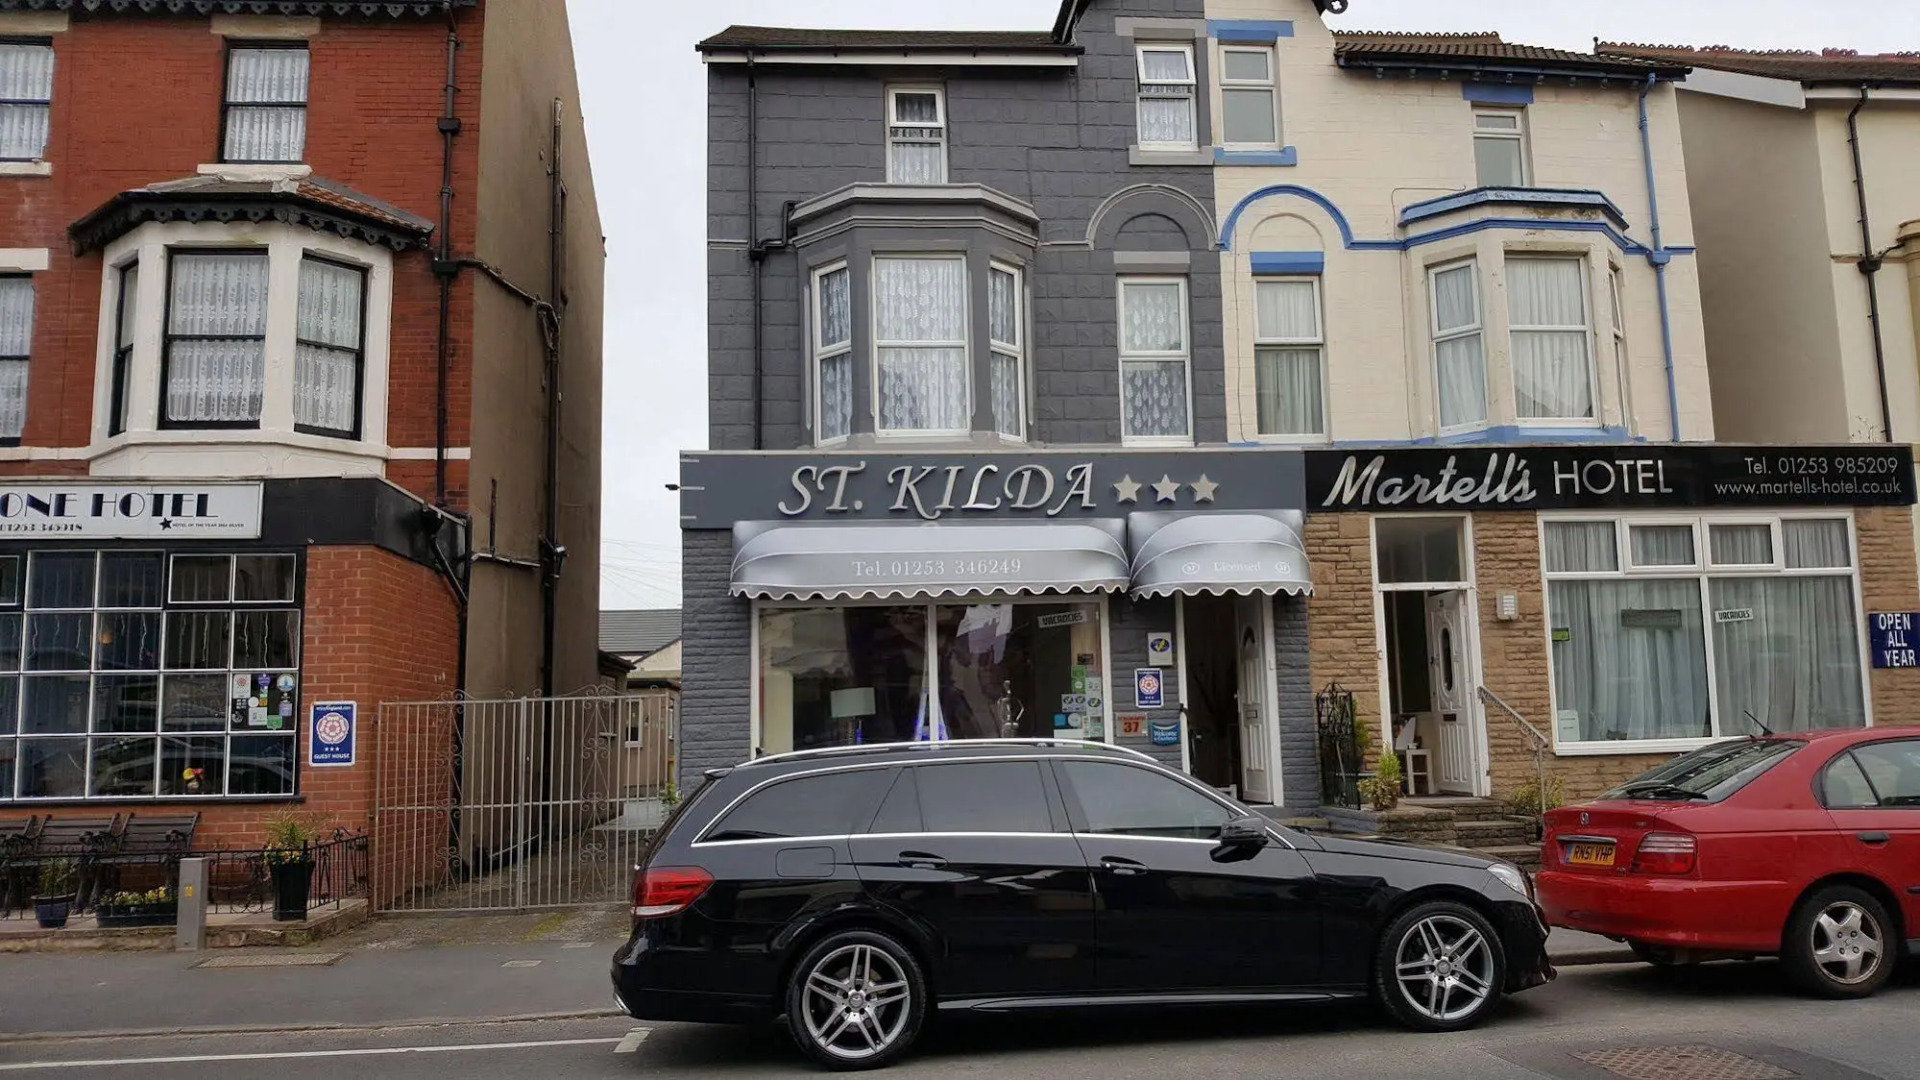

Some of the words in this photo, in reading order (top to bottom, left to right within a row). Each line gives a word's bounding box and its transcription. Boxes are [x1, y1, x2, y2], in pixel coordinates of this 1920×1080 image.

[1744, 456, 1772, 474] Tel.
[1778, 457, 1829, 474] 01253
[1834, 456, 1898, 474] 985209
[1321, 452, 1536, 506] Martell's
[1553, 459, 1673, 494] HOTEL
[1714, 475, 1902, 495] www.martells-hotel.co.uk
[777, 460, 866, 515] ST.
[887, 462, 1097, 520] KILDA
[91, 492, 219, 518] HOTEL
[852, 561, 886, 576] Tel.
[891, 560, 945, 576] 01253
[954, 558, 1021, 575] 346249
[1042, 611, 1083, 626] VACANCIES
[1718, 609, 1750, 620] VACANCIES
[1879, 613, 1911, 630] OPEN
[1887, 630, 1908, 648] ALL
[1884, 649, 1916, 667] YEAR
[1124, 721, 1139, 733] 37
[1574, 845, 1592, 860] RN51
[1594, 846, 1613, 860] VHP
